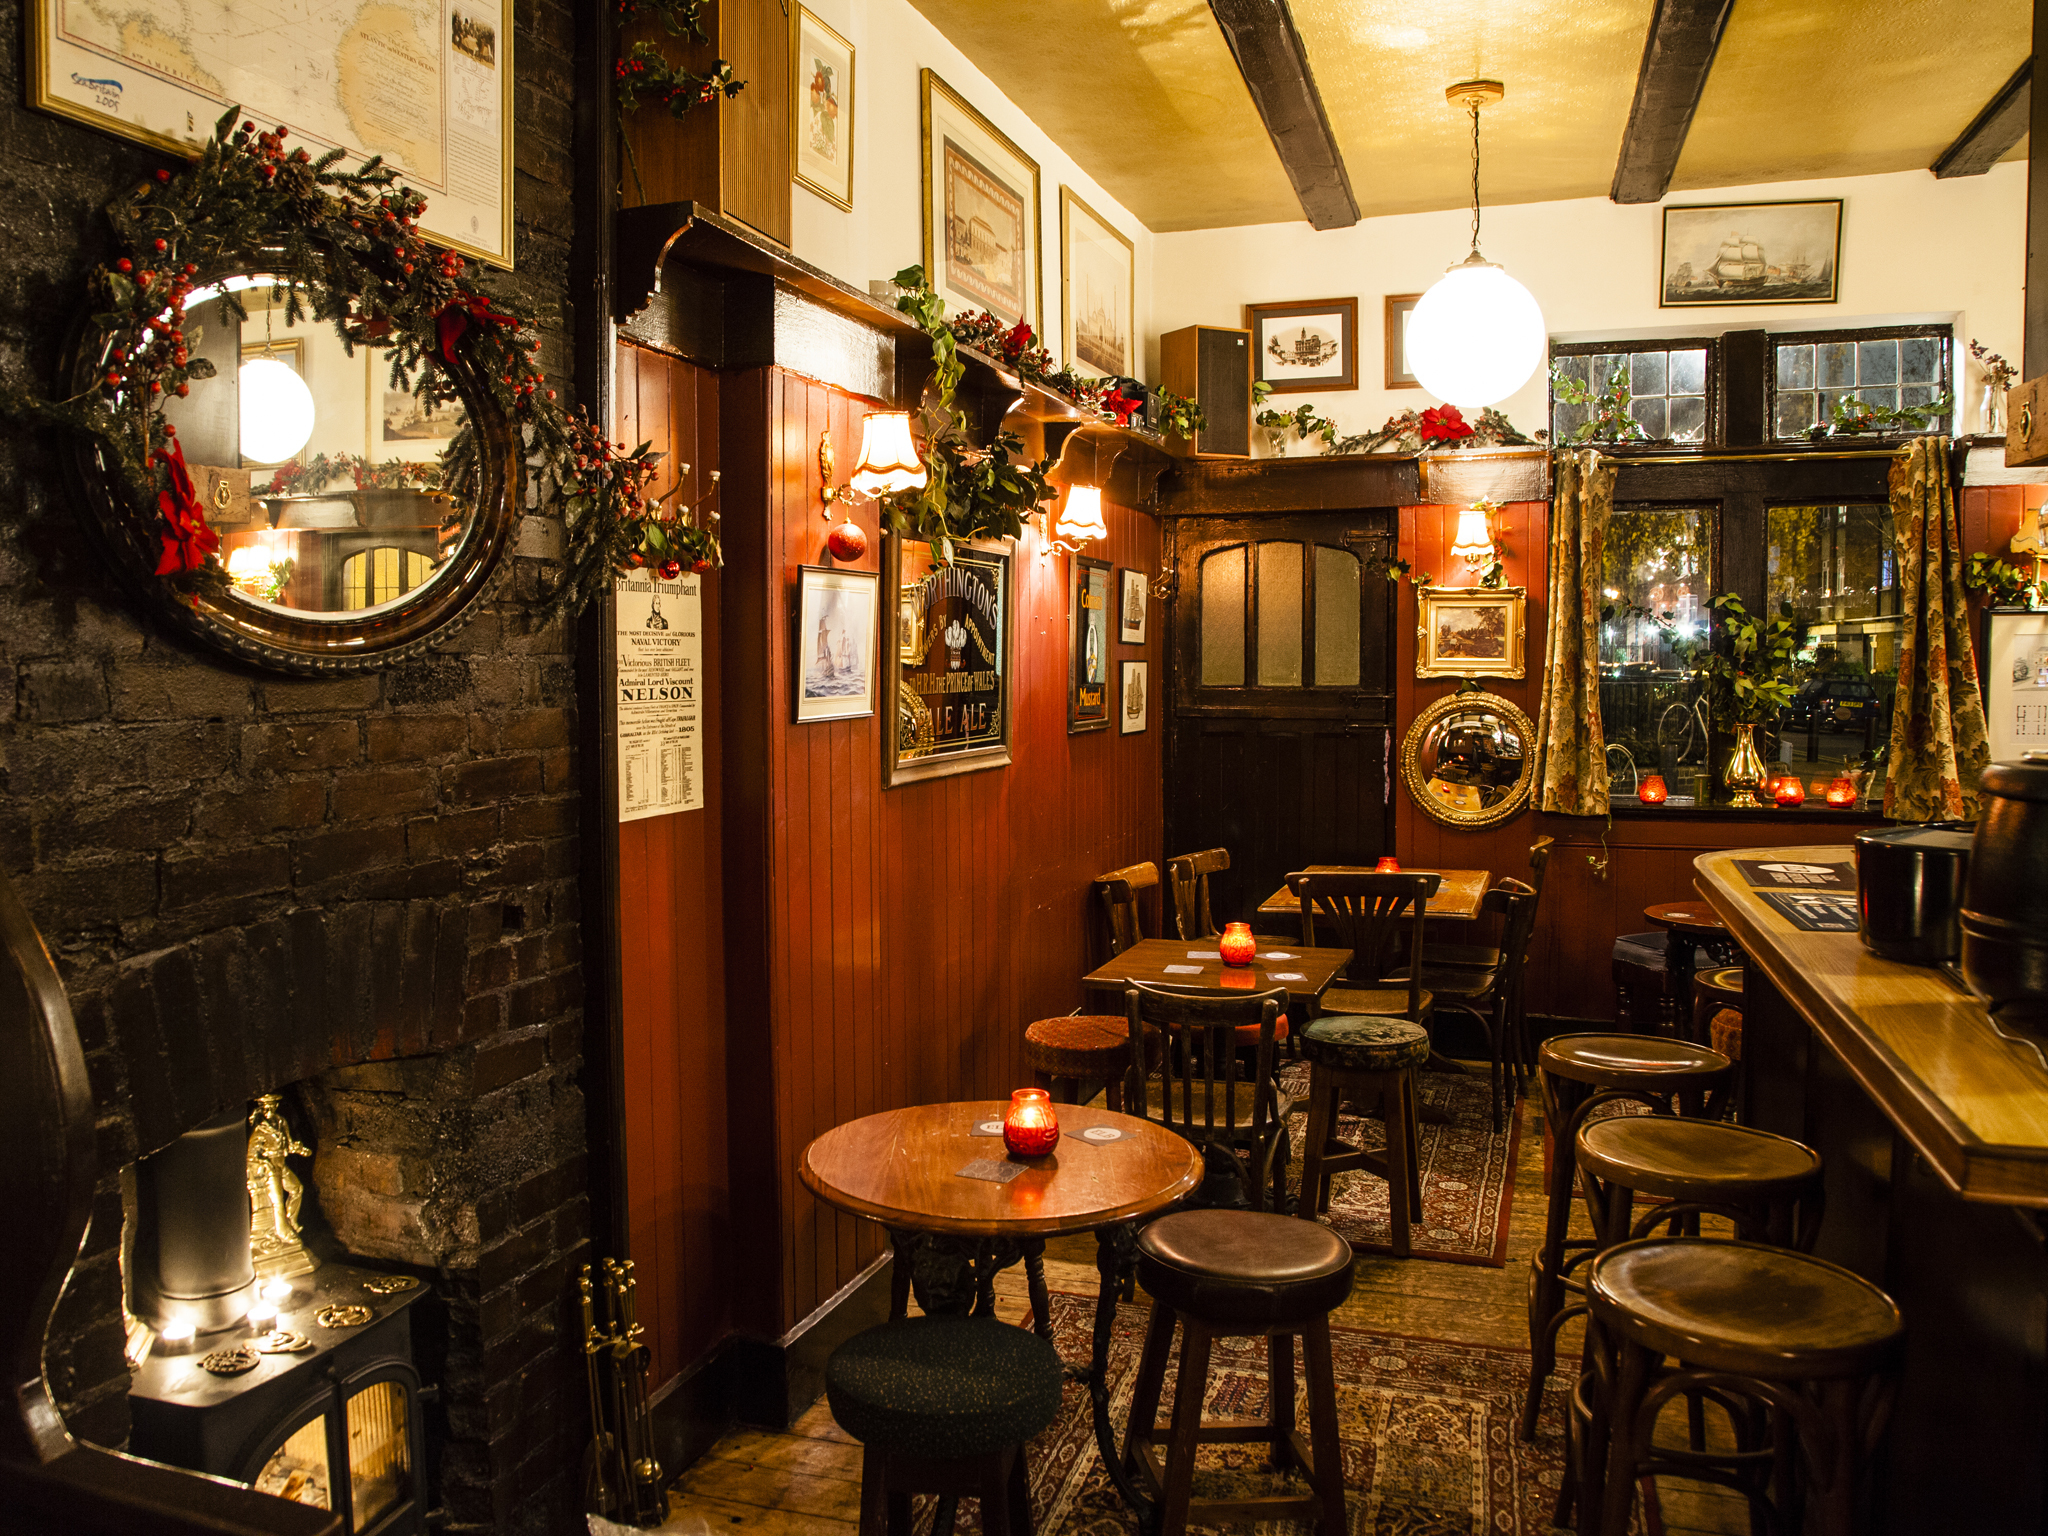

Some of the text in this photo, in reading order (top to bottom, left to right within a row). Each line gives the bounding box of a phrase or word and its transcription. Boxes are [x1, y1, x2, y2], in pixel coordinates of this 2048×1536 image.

[652, 575, 697, 599] Triumphant
[907, 567, 998, 630] WORTHINGTON'S
[631, 638, 682, 647] NAVAL VICTORY
[964, 613, 995, 666] APPOINTMENT
[621, 654, 652, 667] Victorious
[653, 658, 675, 667] BRITISH
[675, 658, 692, 667] FLEET
[619, 677, 694, 687] Admiral Lord Viscount
[946, 671, 969, 694] PRINCE
[621, 686, 694, 701] NELSON
[1079, 687, 1101, 707] Mustard
[960, 702, 987, 733] ALE
